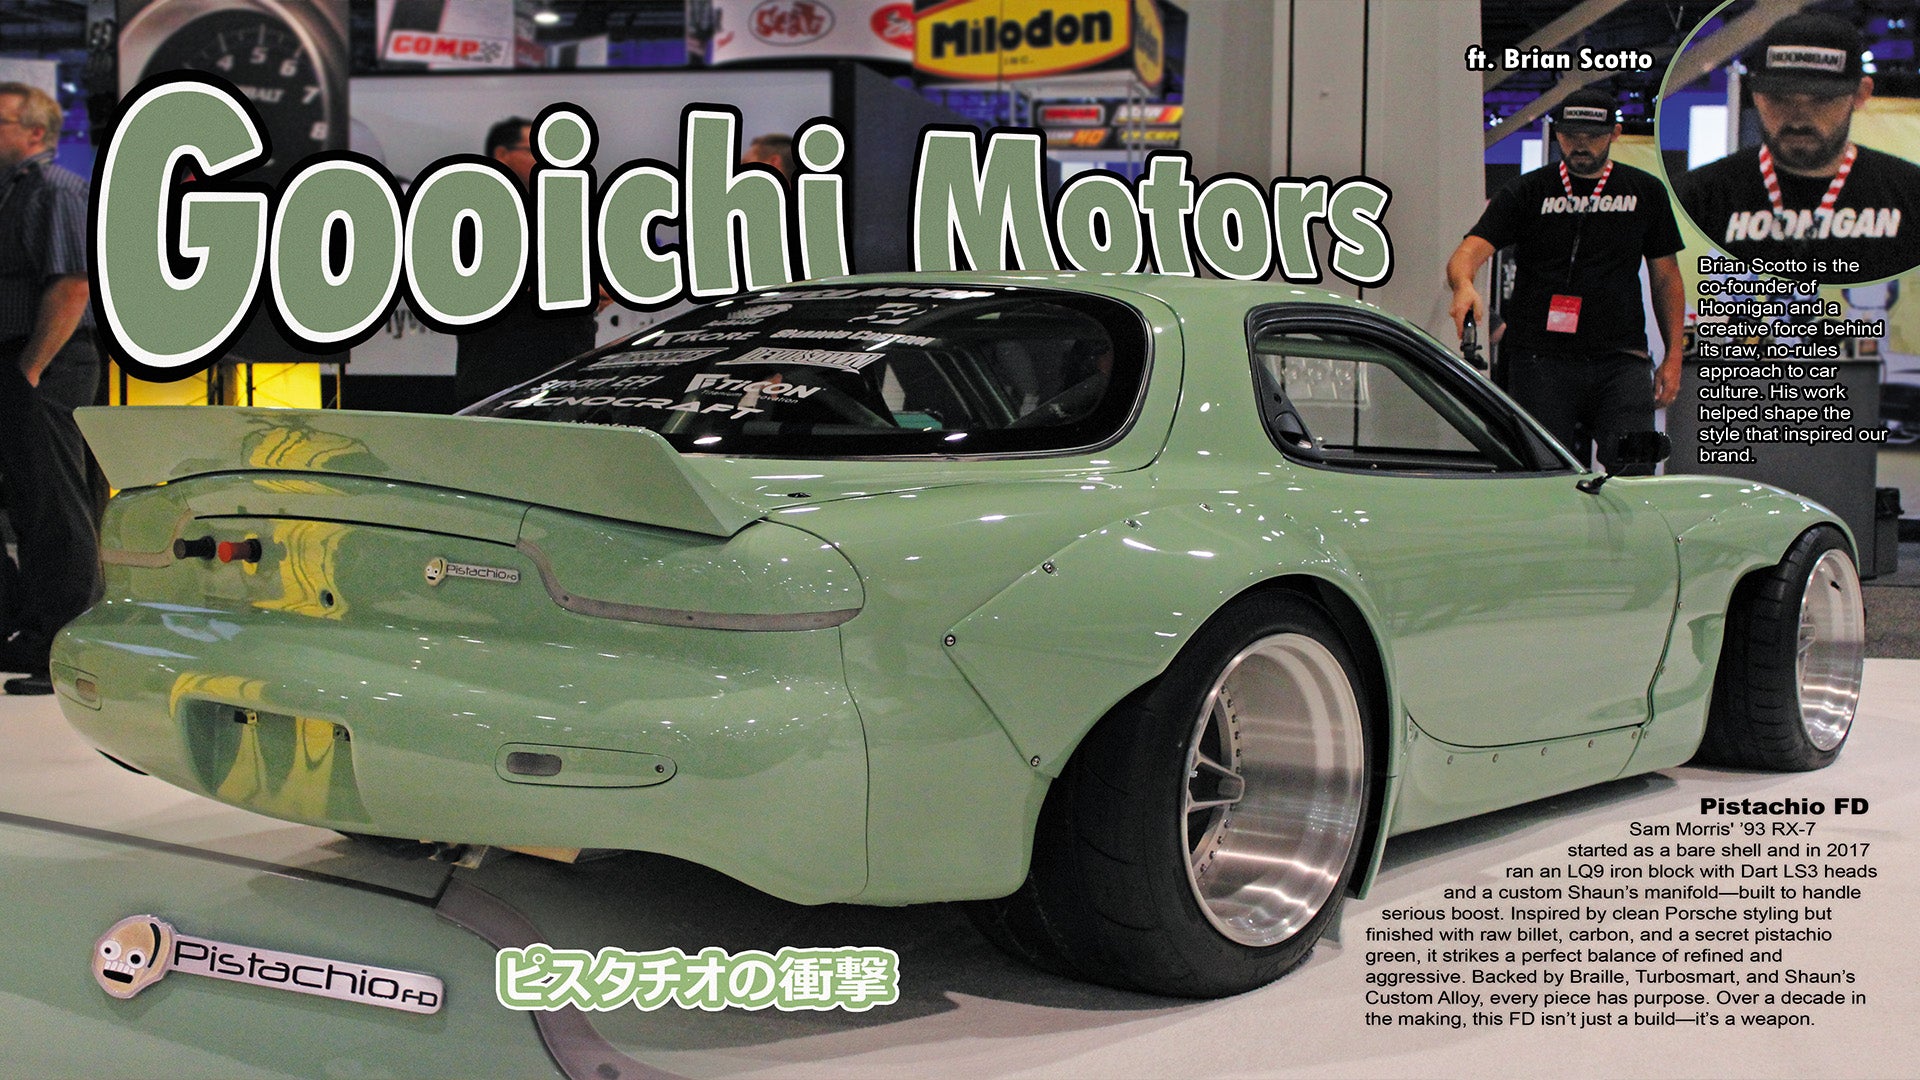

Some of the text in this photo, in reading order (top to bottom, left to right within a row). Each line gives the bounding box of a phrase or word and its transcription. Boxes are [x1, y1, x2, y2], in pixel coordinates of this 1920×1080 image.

[393, 35, 480, 57] COMP
[931, 10, 1112, 60] Milodon
[446, 564, 507, 580] Pistachio
